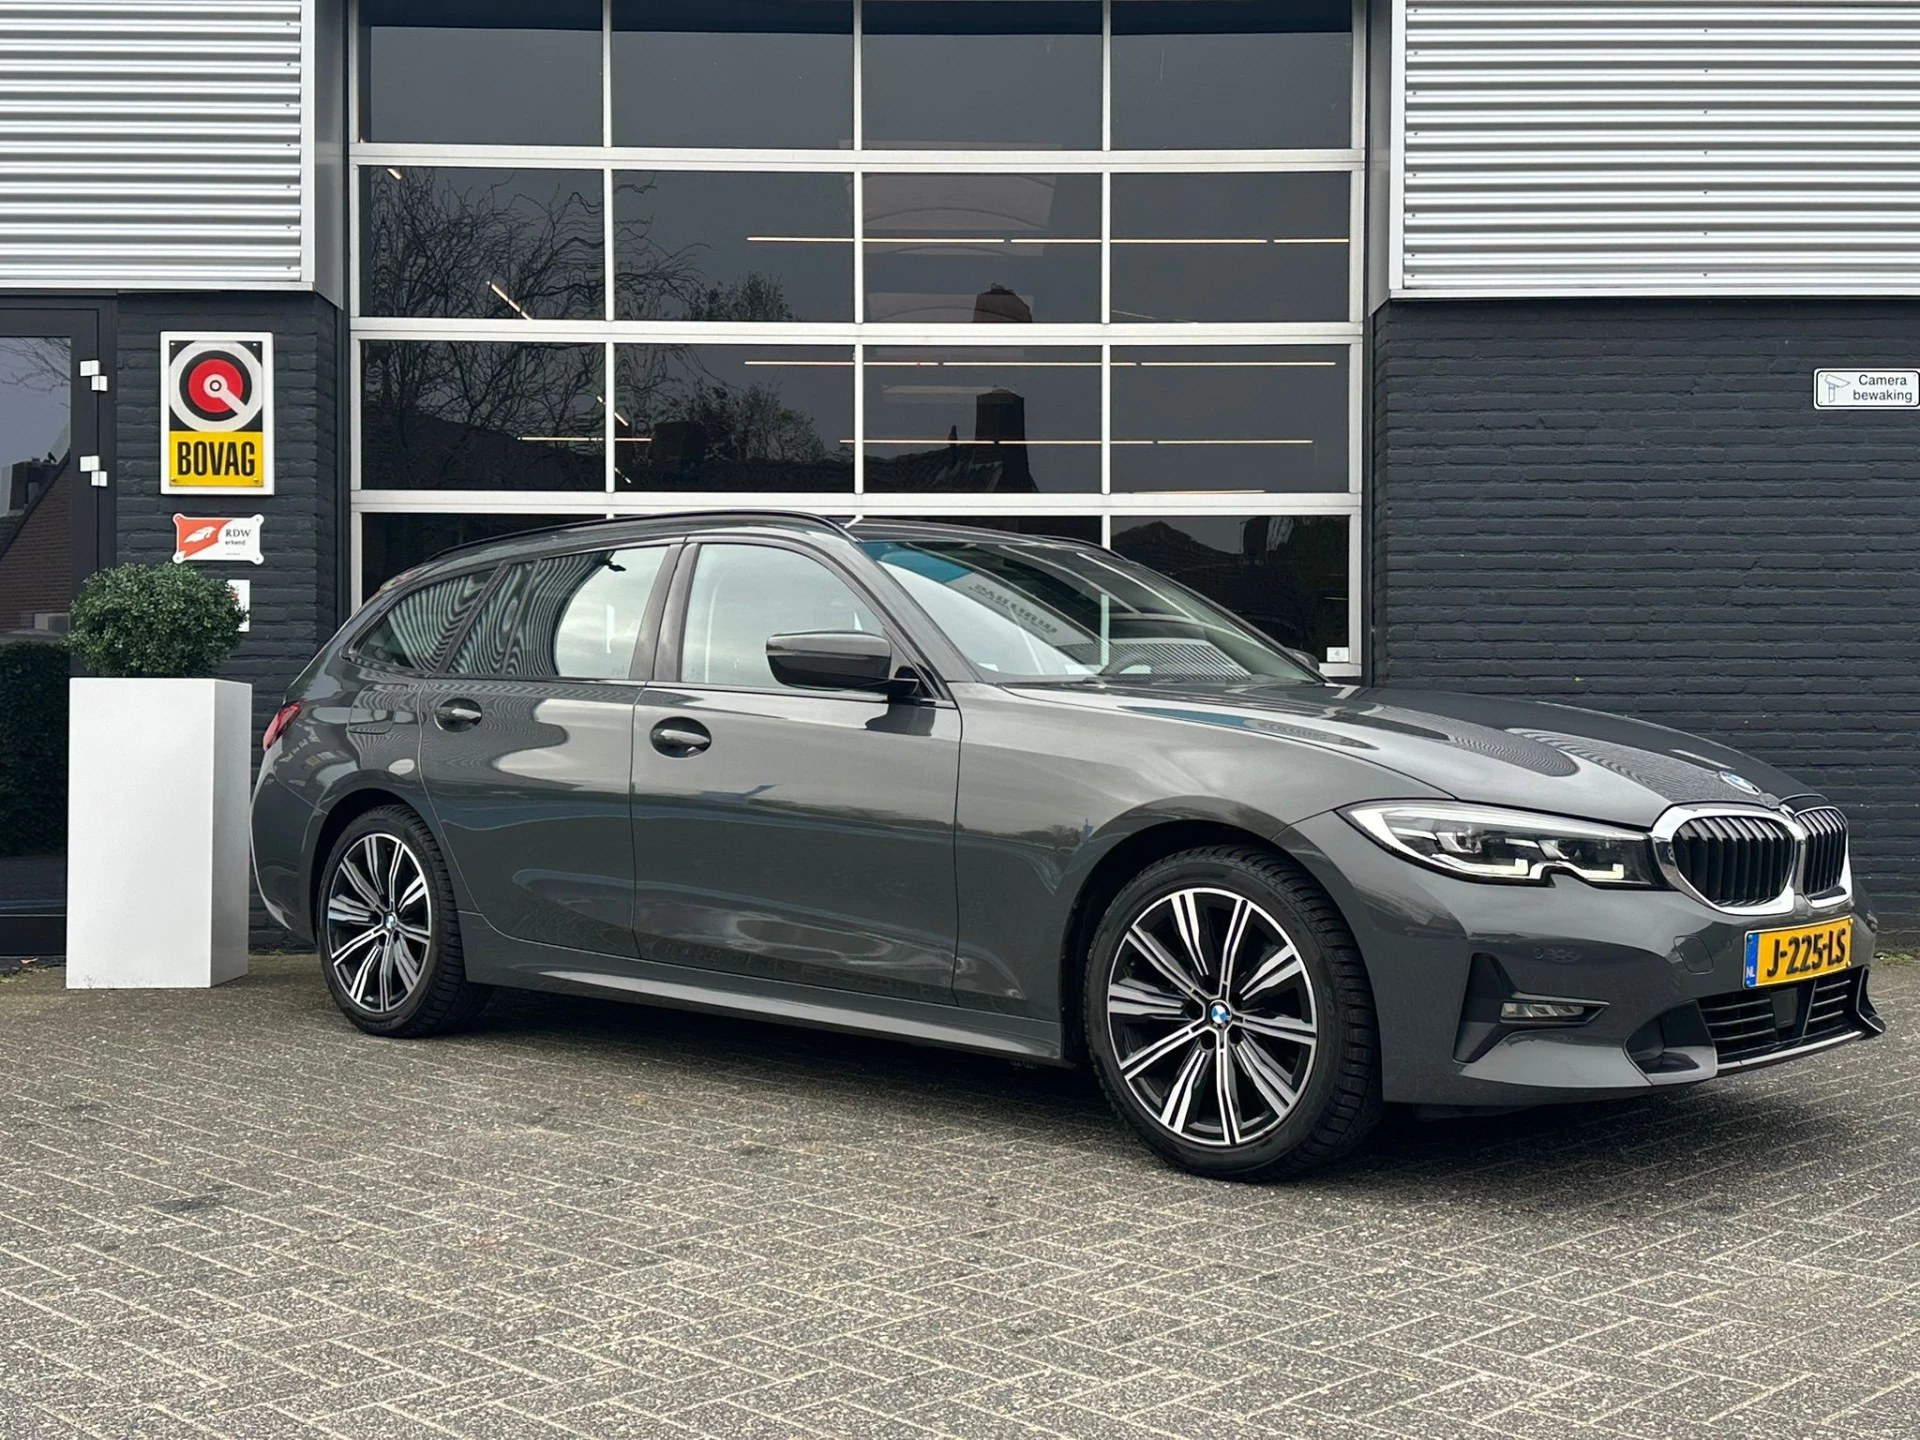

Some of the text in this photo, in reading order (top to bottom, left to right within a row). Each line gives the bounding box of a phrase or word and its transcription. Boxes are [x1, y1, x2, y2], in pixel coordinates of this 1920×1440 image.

[1858, 374, 1907, 386] Camera
[1853, 389, 1913, 403] bewaking
[177, 441, 256, 476] BOVAG
[225, 529, 251, 538] RDW
[1767, 928, 1846, 978] J-225-LS
[1746, 966, 1755, 978] NL
